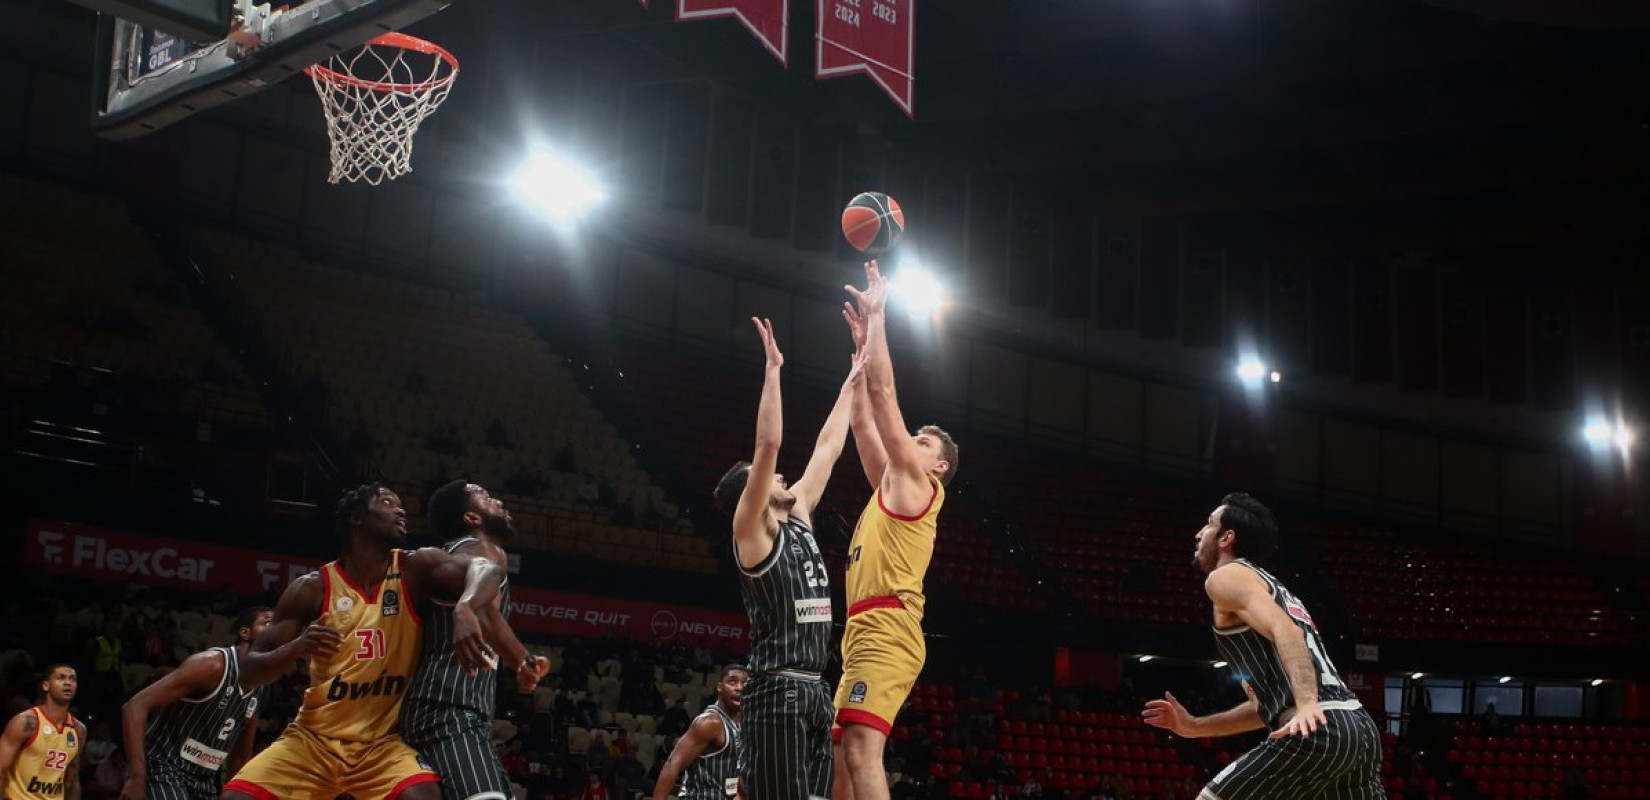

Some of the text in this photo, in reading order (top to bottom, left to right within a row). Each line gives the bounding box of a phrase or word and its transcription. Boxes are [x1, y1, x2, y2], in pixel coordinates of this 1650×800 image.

[835, 3, 860, 28] 2024
[873, 1, 896, 24] 2023
[149, 49, 171, 69] GBL
[71, 535, 214, 582] FlexCar
[509, 601, 631, 626] NEVER QUIT
[680, 620, 744, 640] NEVER
[355, 629, 386, 661] 31
[328, 669, 404, 700] bwin
[218, 718, 236, 740] 2
[44, 749, 68, 770] 22
